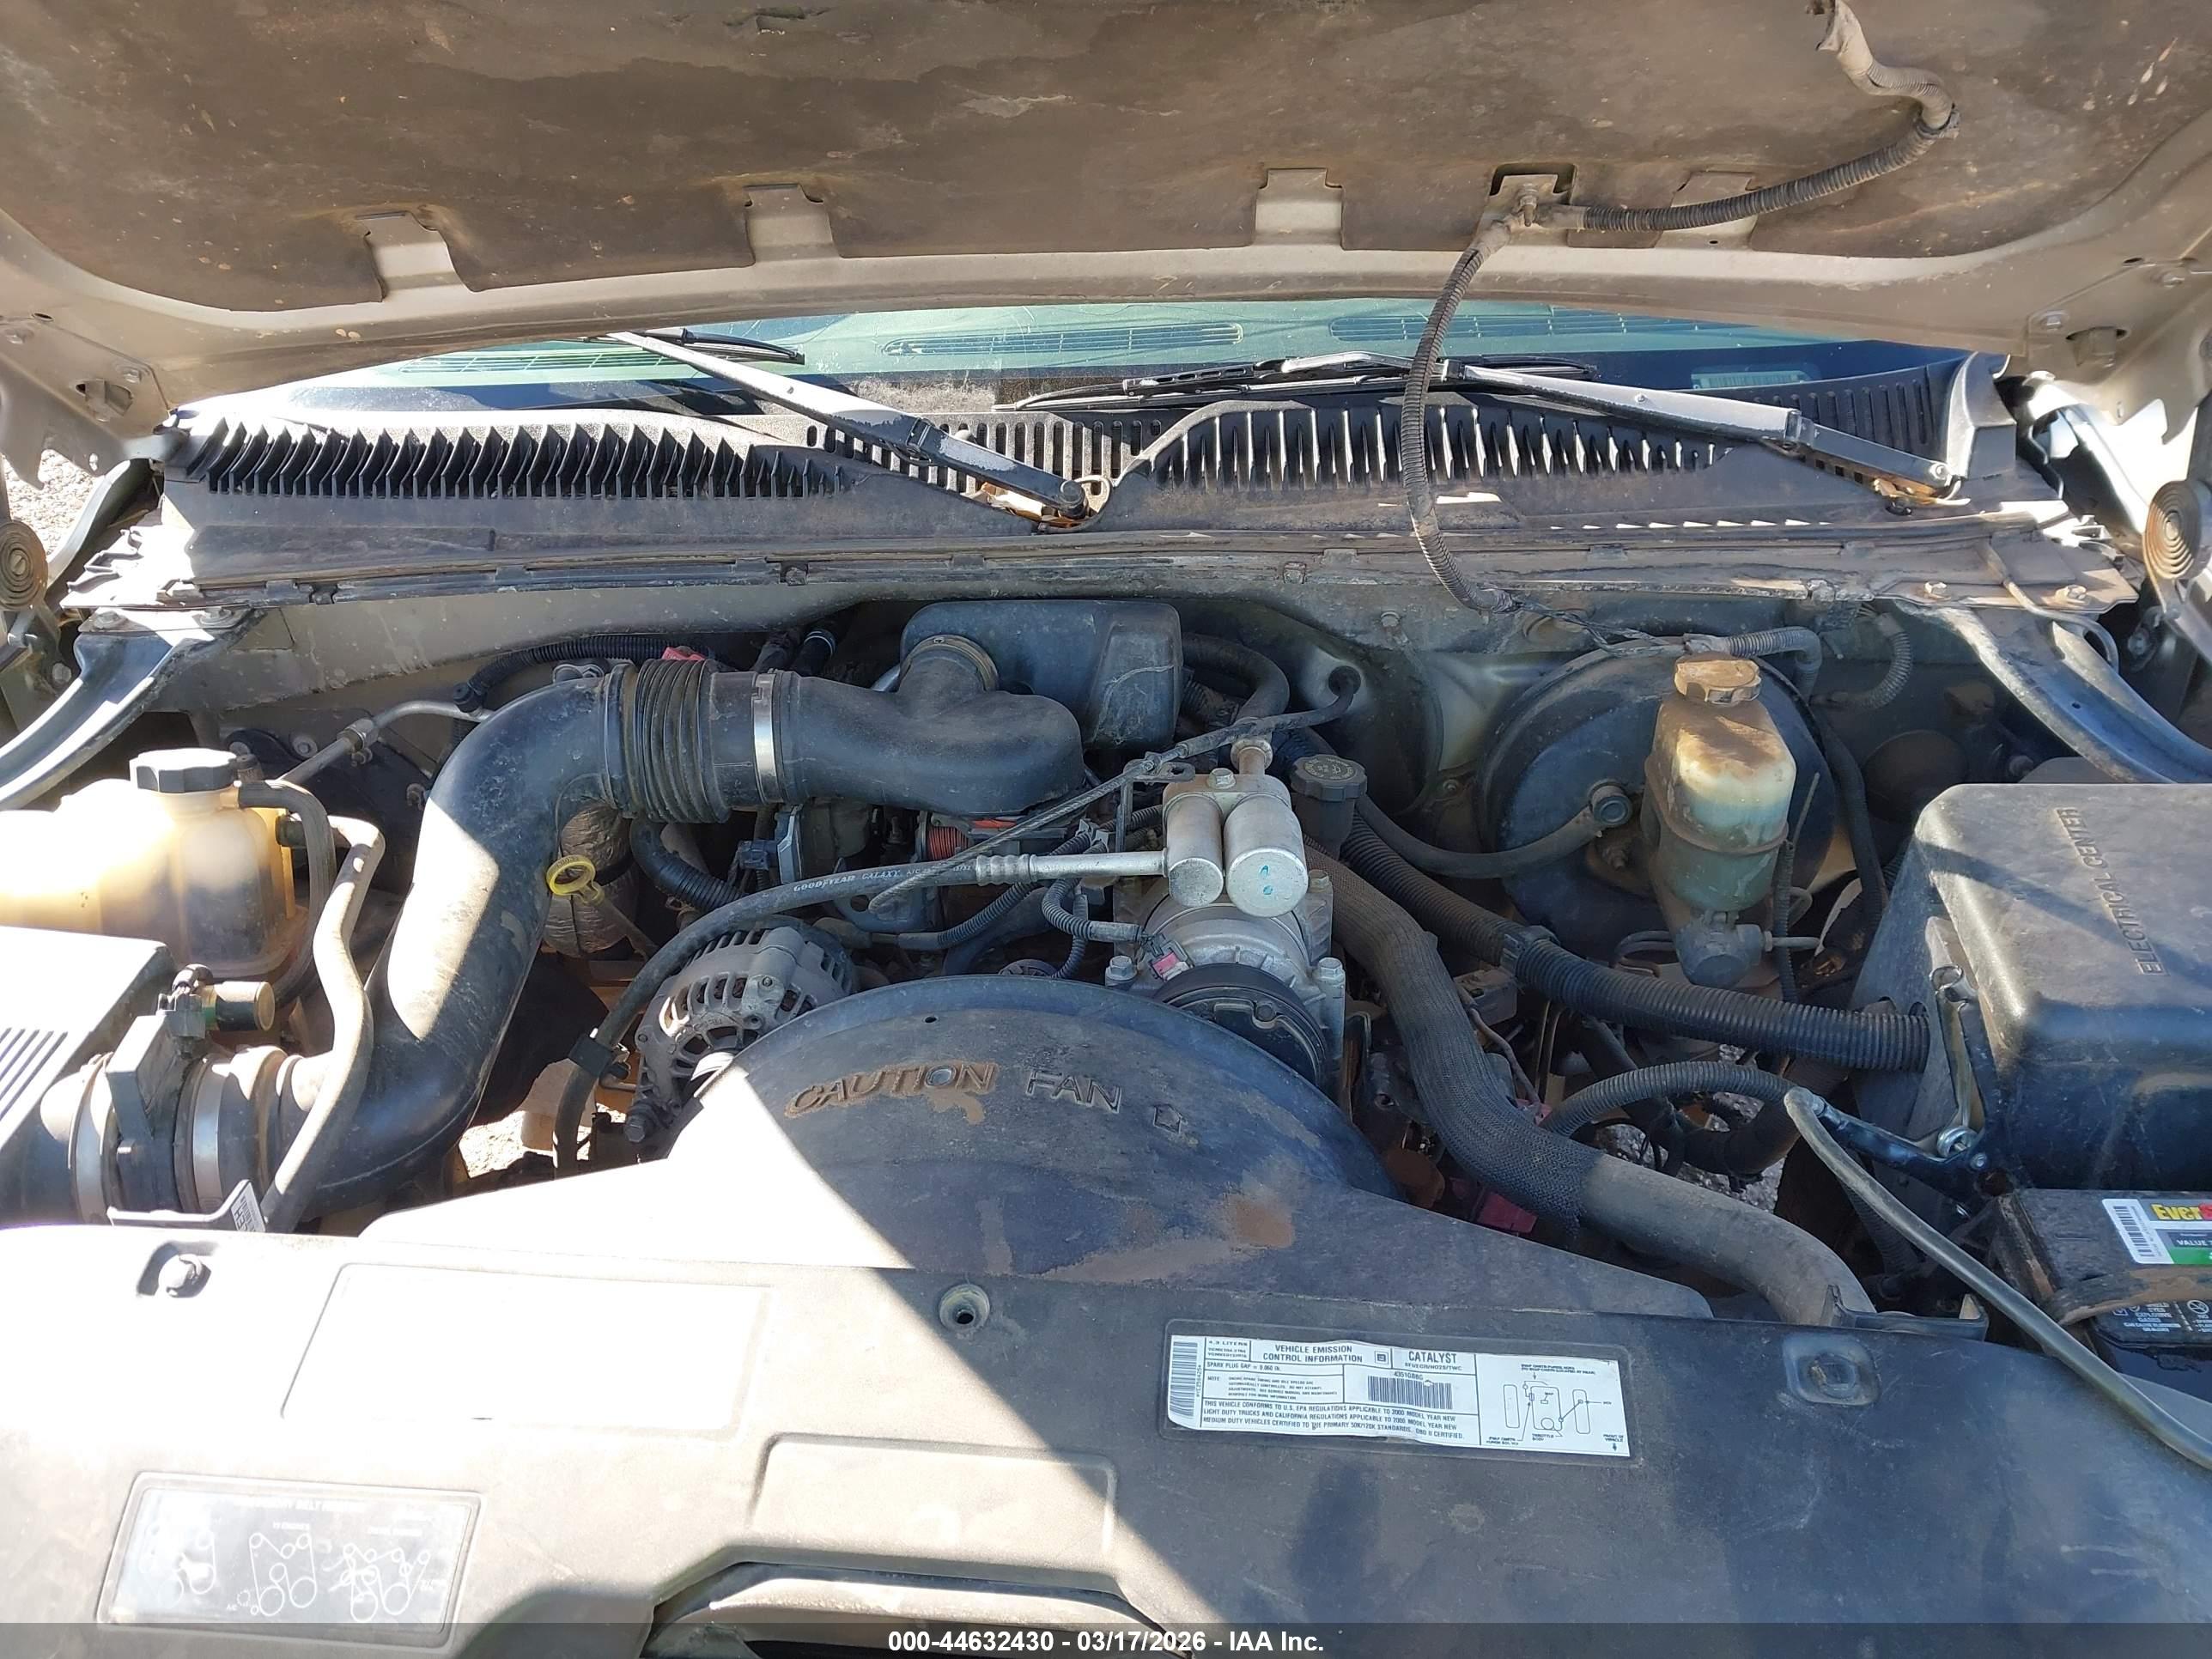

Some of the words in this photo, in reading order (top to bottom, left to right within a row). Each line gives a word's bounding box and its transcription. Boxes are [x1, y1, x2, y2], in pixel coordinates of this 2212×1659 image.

[2055, 807, 2109, 868] CENTER
[793, 874, 855, 892] GOODYEAR
[862, 869, 901, 880] GALAXY
[2092, 872, 2169, 976] ELECTRICAL
[789, 1063, 999, 1115] CAUTION
[1025, 1067, 1122, 1114] FAN
[1274, 1344, 1309, 1353] VEHICLE
[1312, 1345, 1352, 1354] EMISSION
[1263, 1352, 1302, 1363] CONTROL
[1304, 1353, 1363, 1364] INFORMATION
[1408, 1351, 1457, 1364] CATALYST
[1348, 1406, 1382, 1414] APPLICABLE
[1406, 1411, 1425, 1419] MODEL
[1272, 1419, 1300, 1428] CERTIFIED
[1349, 1413, 1382, 1422] APPLICABLE
[1407, 1419, 1425, 1428] MODEL
